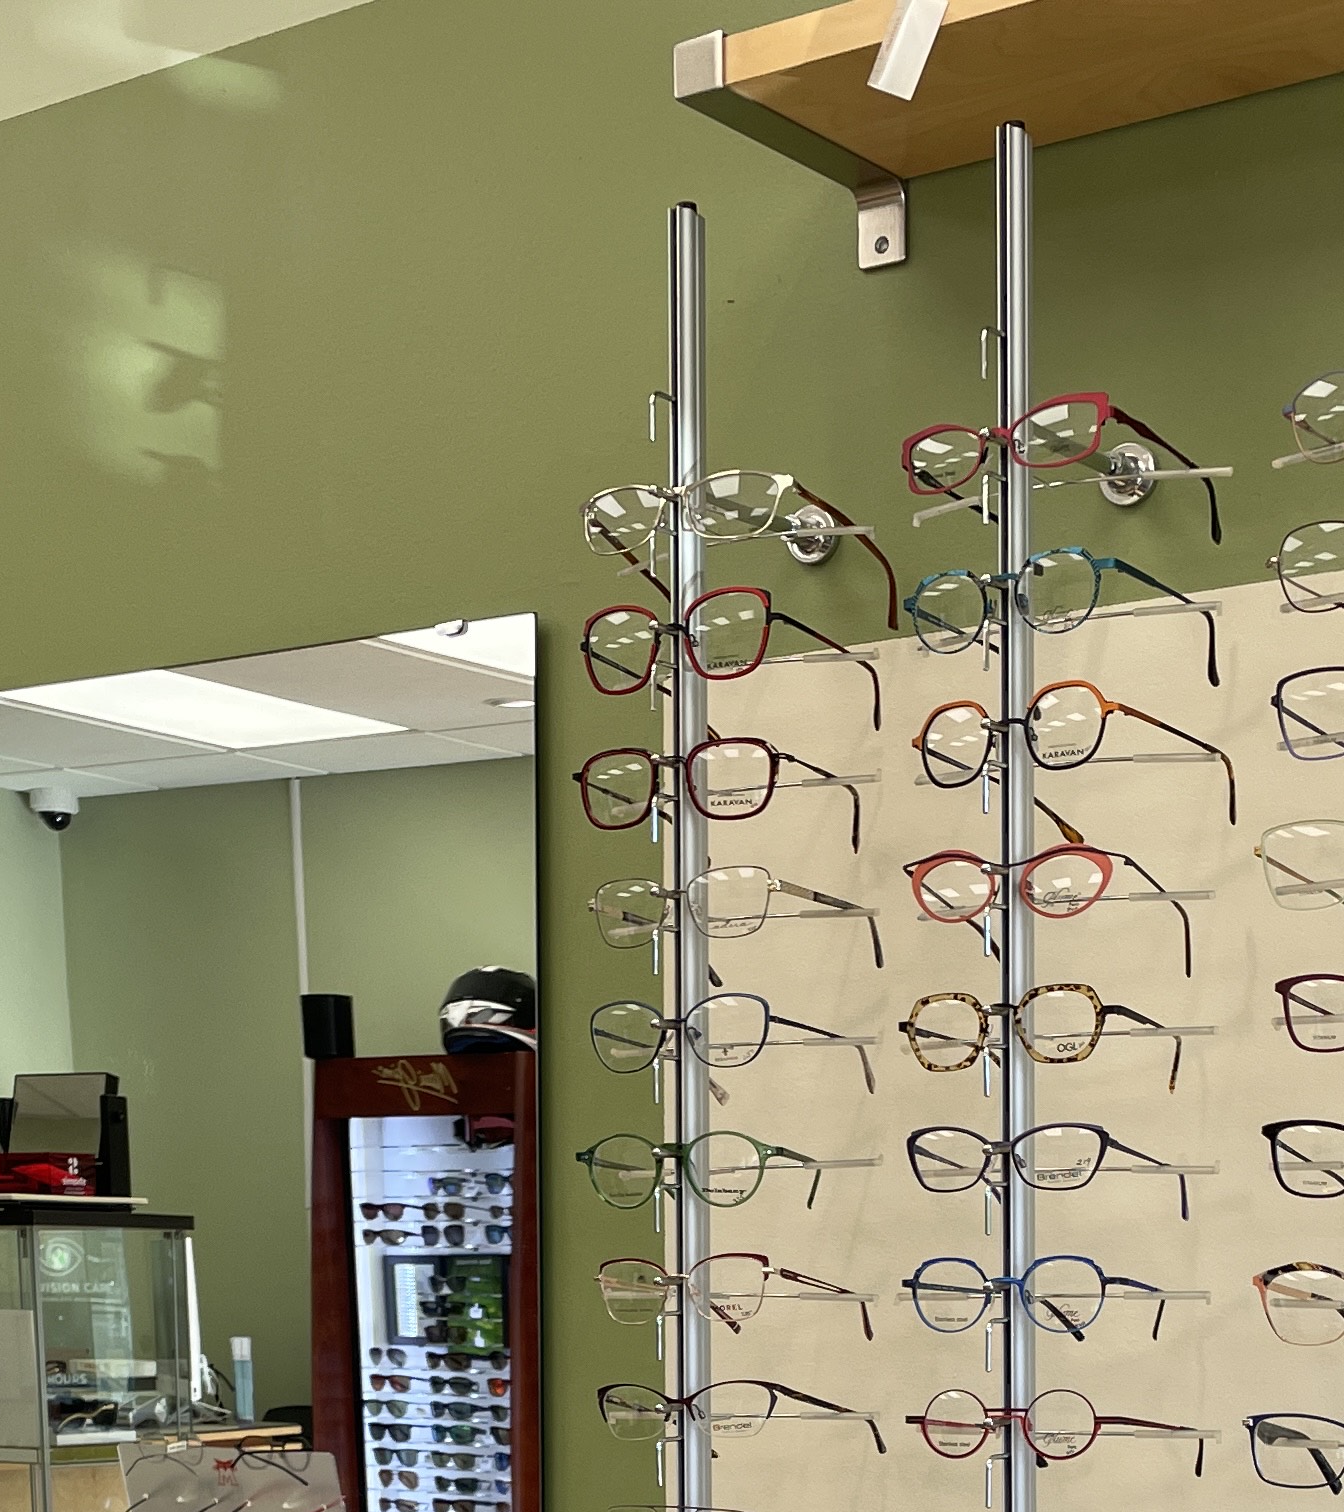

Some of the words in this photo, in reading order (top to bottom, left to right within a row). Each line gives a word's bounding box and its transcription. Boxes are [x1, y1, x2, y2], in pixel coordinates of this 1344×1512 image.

[1042, 748, 1085, 759] KARAVAN
[710, 798, 753, 808] KARAVAN
[1037, 1170, 1082, 1182] Brendel
[712, 1422, 752, 1432] Brendel
